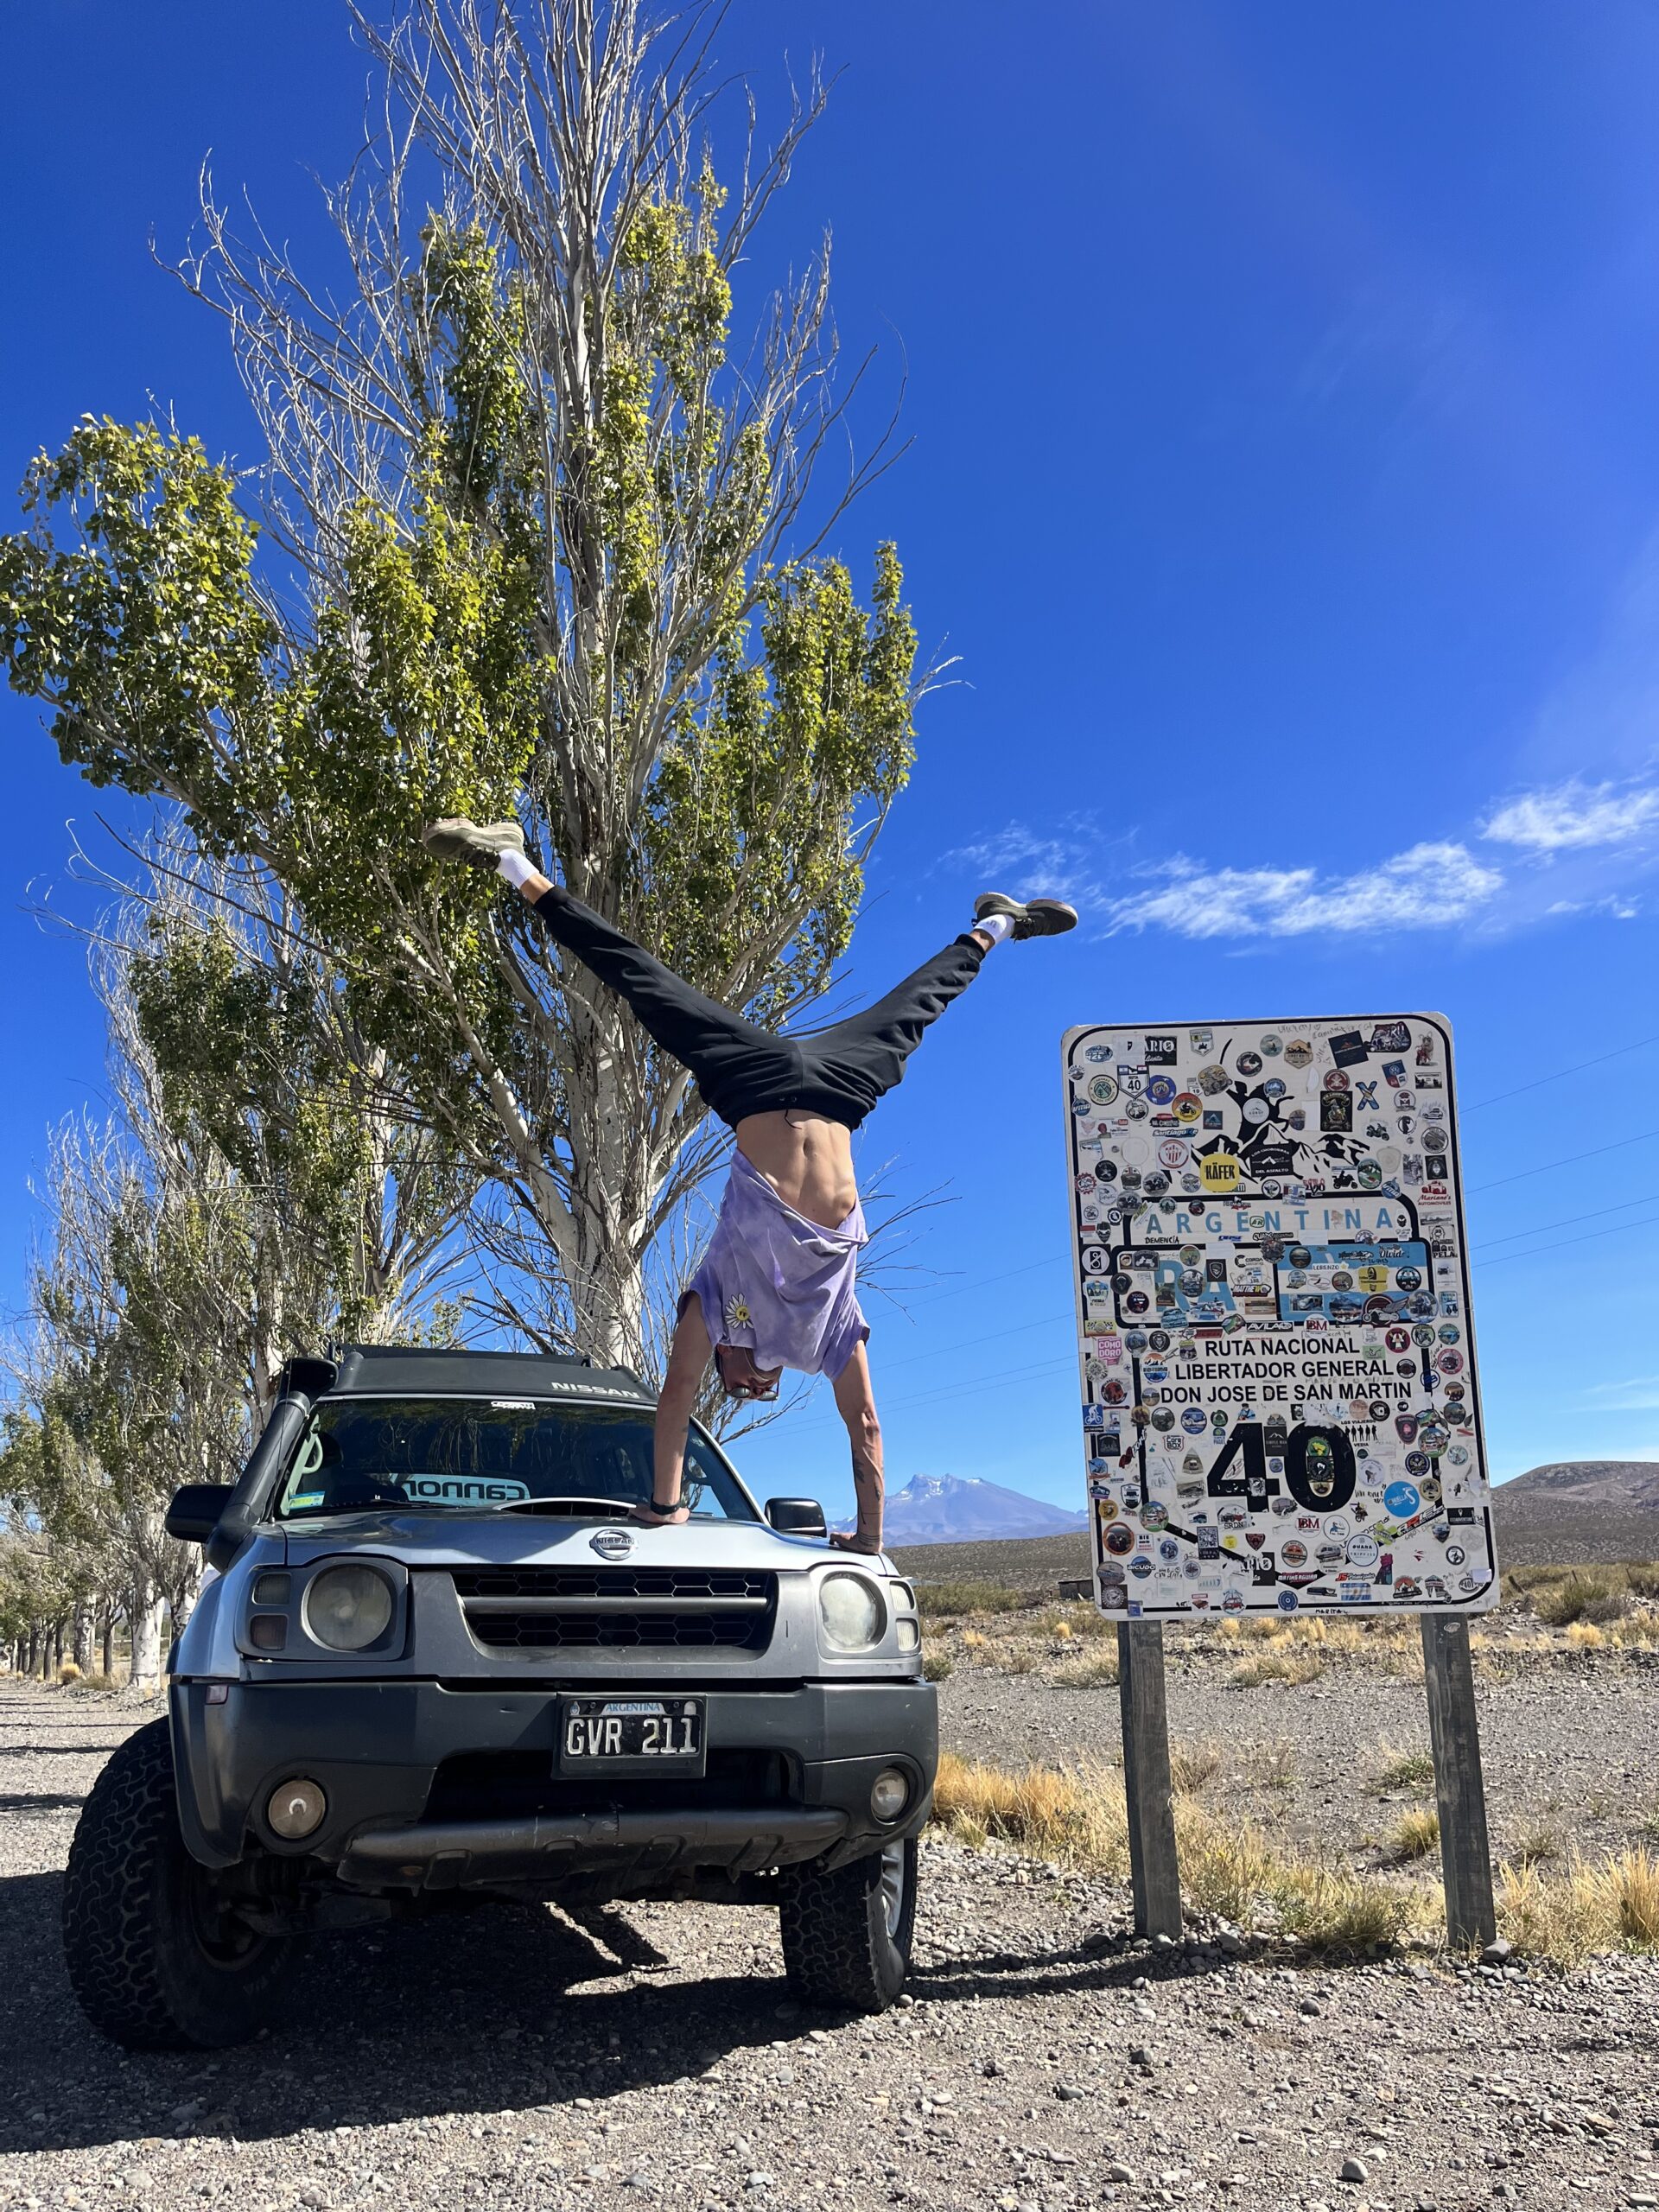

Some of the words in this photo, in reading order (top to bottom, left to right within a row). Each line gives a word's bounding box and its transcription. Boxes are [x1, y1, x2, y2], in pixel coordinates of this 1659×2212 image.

[1127, 1080, 1141, 1091] 40
[1205, 1161, 1236, 1180] KÄFER
[1146, 1208, 1393, 1235] ARGENTINA
[1098, 1340, 1121, 1350] COMO
[1099, 1349, 1122, 1358] DORO
[1205, 1339, 1256, 1357] RUTA
[1261, 1338, 1360, 1356] NACIONAL
[1175, 1362, 1297, 1380] LIBERTADOR
[1302, 1359, 1394, 1377] GENERAL
[550, 1382, 641, 1399] NISSAN
[1161, 1386, 1202, 1403] DON
[1207, 1385, 1257, 1402] JOSE
[1263, 1385, 1288, 1402] DE
[1294, 1383, 1333, 1401] SAN
[1339, 1382, 1412, 1400] MARTIN
[1207, 1422, 1357, 1513] 40
[606, 1702, 661, 1712] ARGENTINA
[567, 1717, 623, 1755] GVR
[642, 1717, 696, 1754] 211
